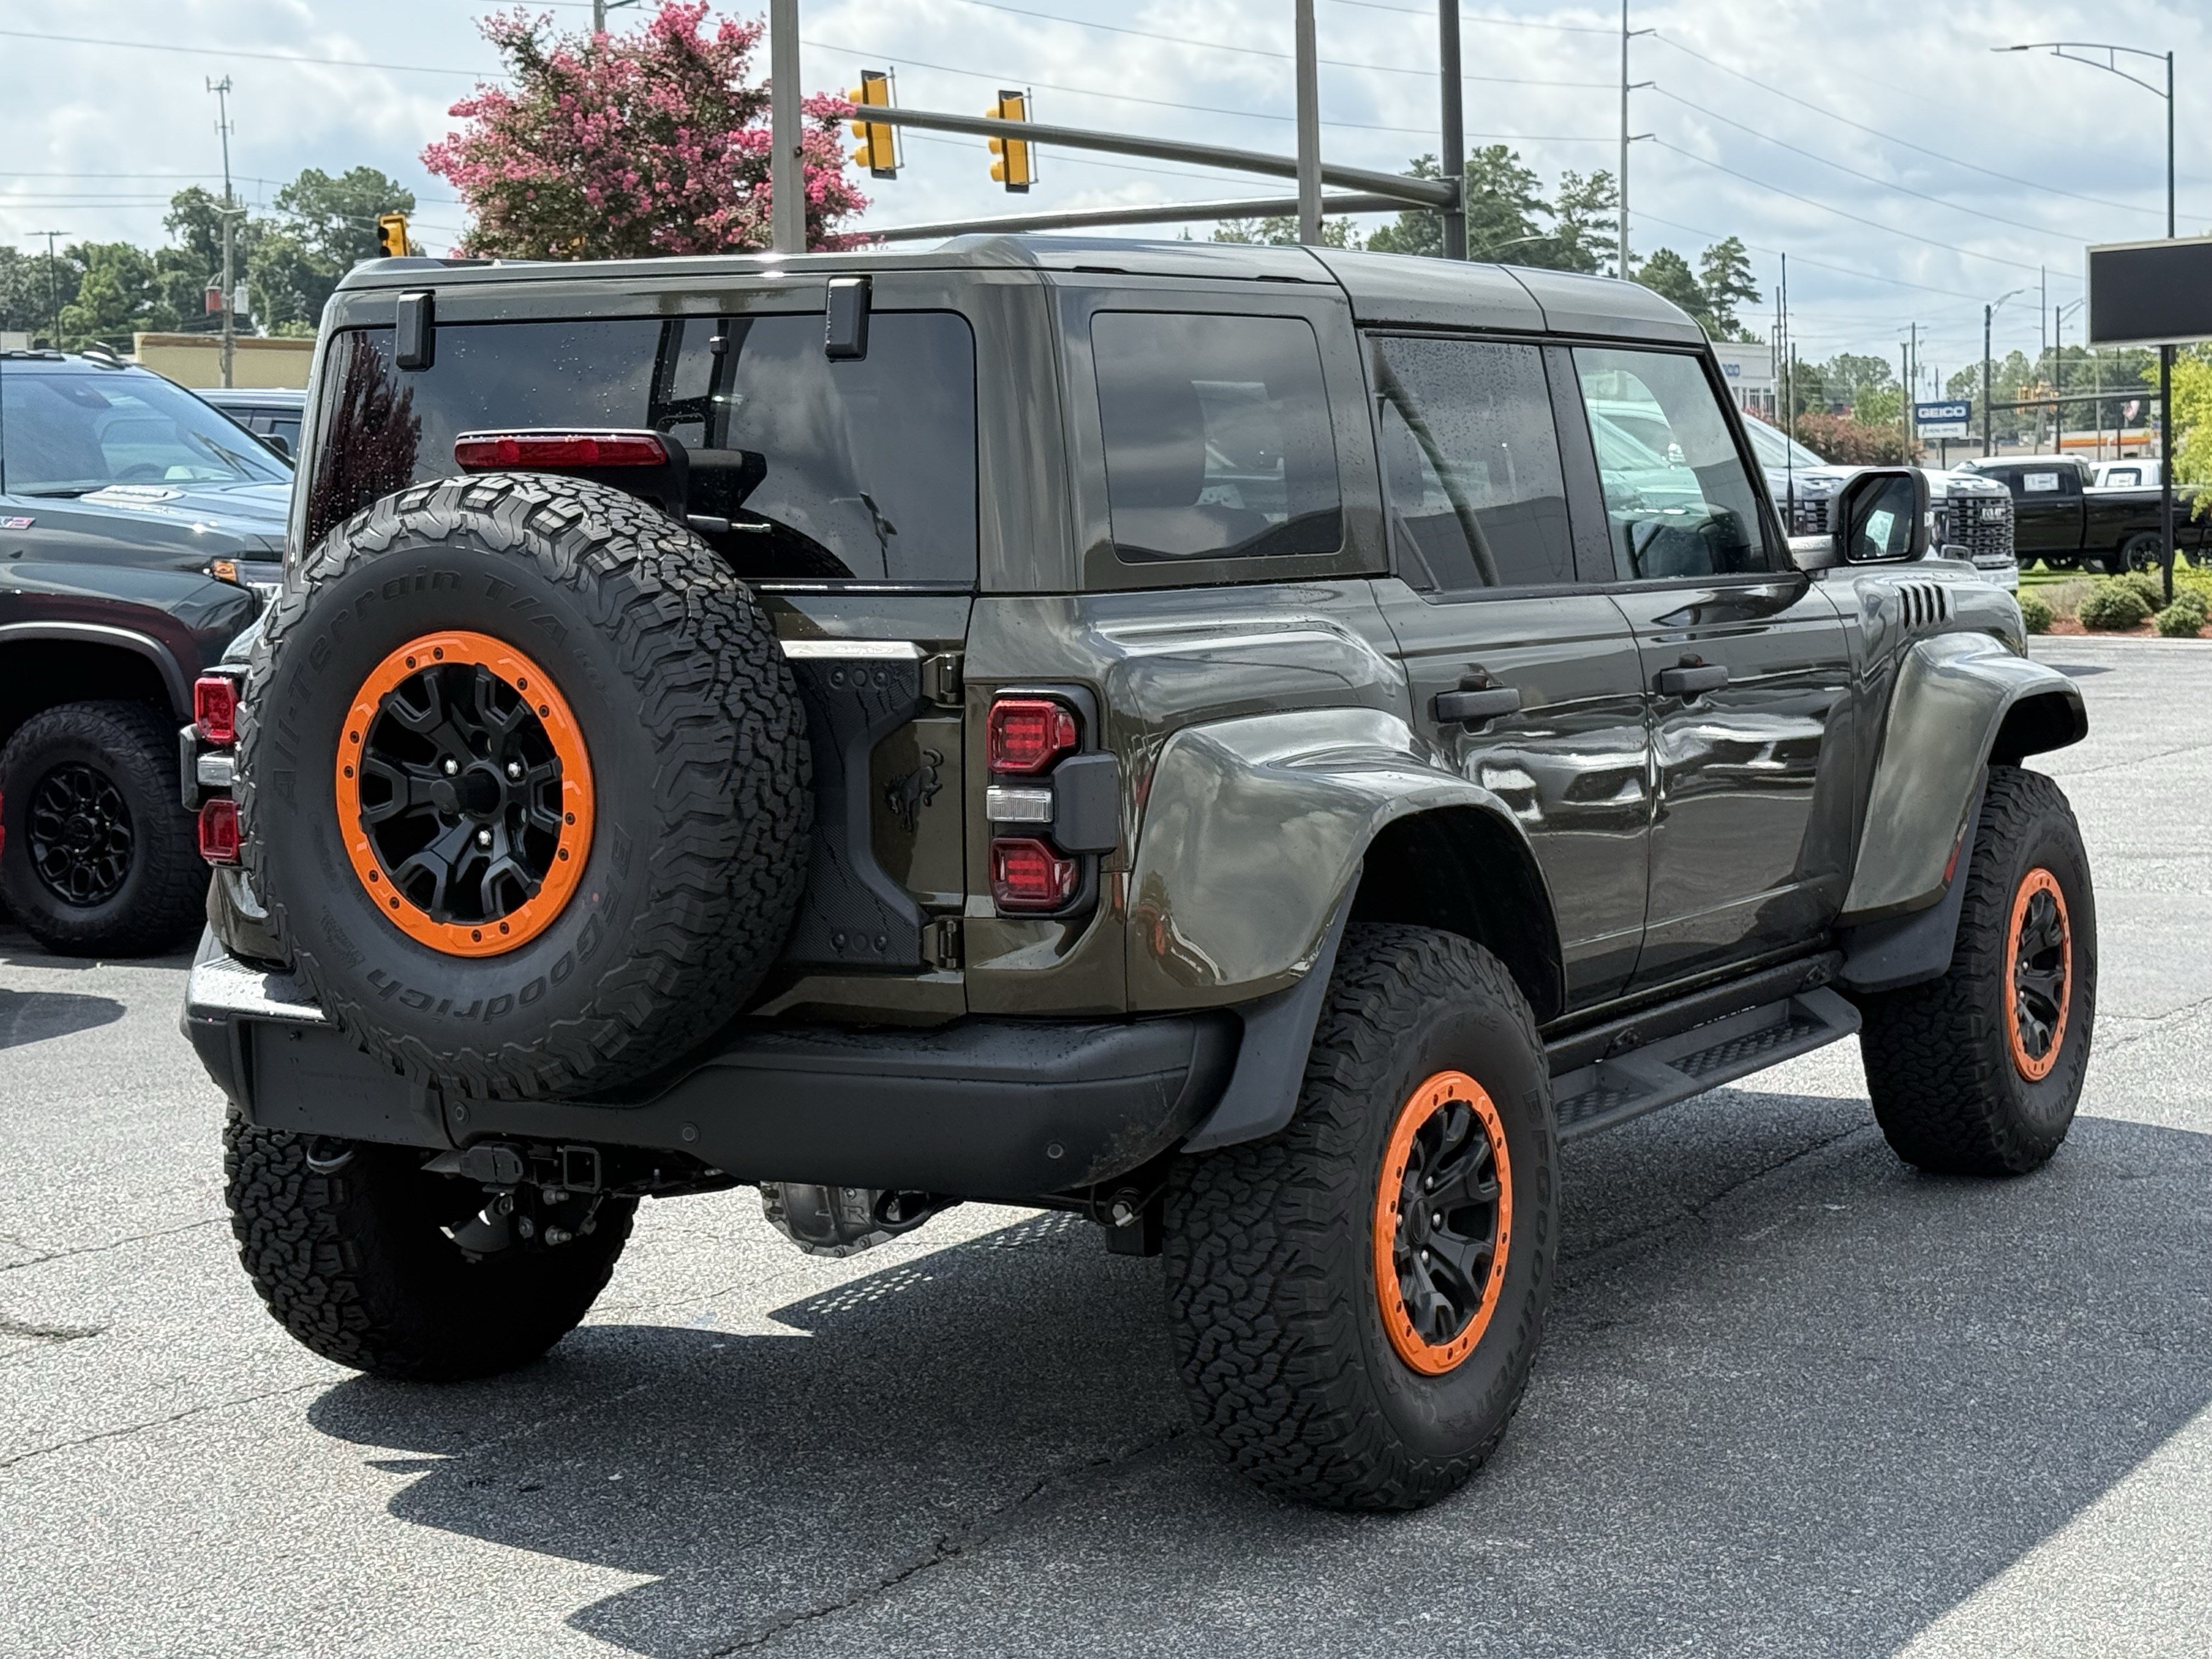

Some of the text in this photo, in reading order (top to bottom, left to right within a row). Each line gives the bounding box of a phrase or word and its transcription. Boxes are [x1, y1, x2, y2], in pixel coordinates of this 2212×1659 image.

[1918, 406, 1966, 419] GEICO
[273, 564, 463, 815] All-Terrain
[483, 572, 568, 648] T/A
[366, 821, 633, 1025] BFGoodrich
